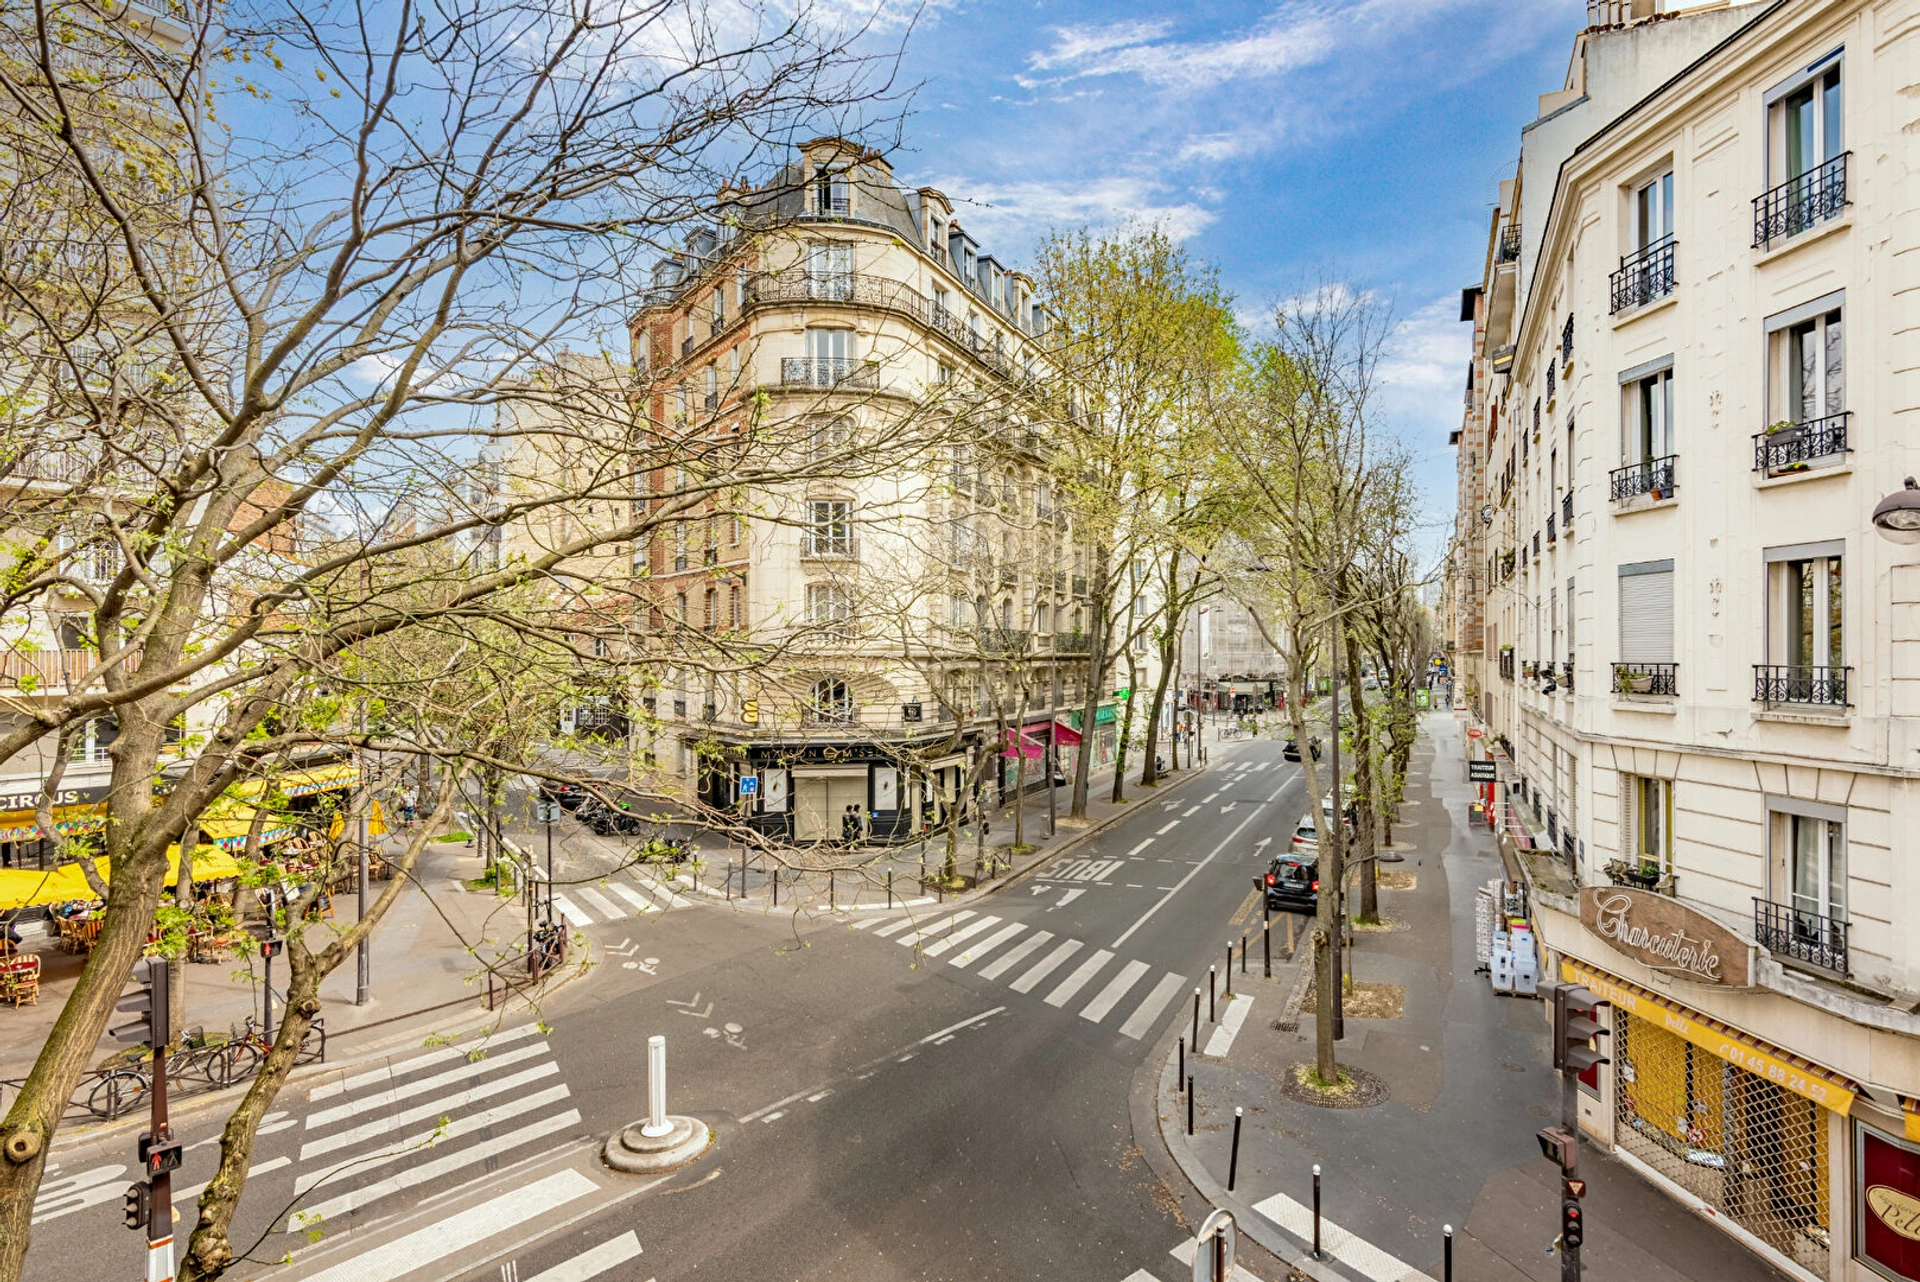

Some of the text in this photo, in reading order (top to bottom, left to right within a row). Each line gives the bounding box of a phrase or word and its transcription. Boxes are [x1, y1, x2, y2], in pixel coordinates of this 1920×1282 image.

[1592, 887, 1722, 980] Charcuterie
[1574, 970, 1636, 1010] TRAITEUR
[1730, 1047, 1745, 1063] 01
[1747, 1056, 1764, 1073] 45
[1768, 1065, 1786, 1082] 88
[1789, 1074, 1806, 1092] 24
[1810, 1084, 1828, 1101] 52
